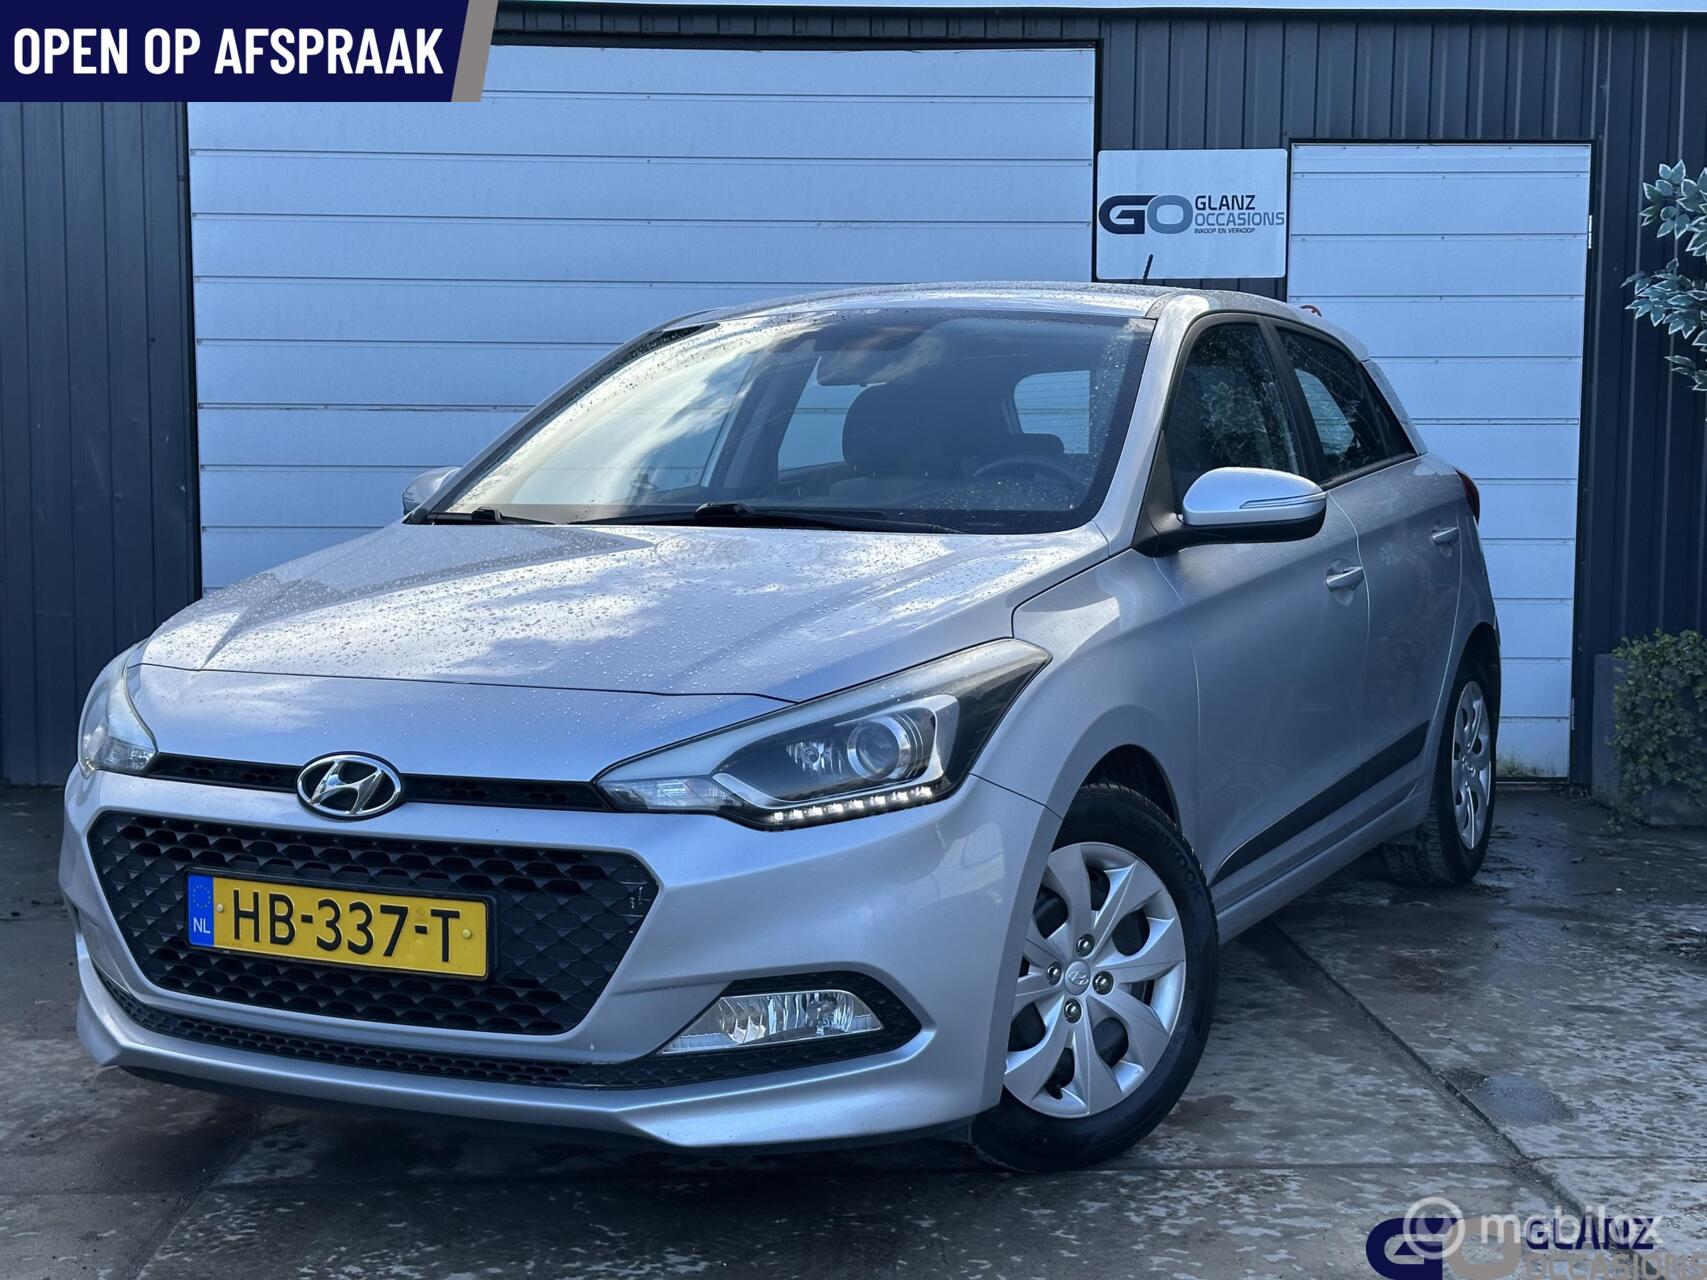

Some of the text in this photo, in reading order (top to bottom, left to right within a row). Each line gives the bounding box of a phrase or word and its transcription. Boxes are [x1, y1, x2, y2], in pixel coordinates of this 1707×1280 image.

[1195, 195, 1256, 211] GLANZ
[1098, 195, 1194, 235] GO
[1195, 212, 1285, 226] OCCASIONS
[193, 916, 212, 934] NL
[232, 889, 461, 963] HB-337-T
